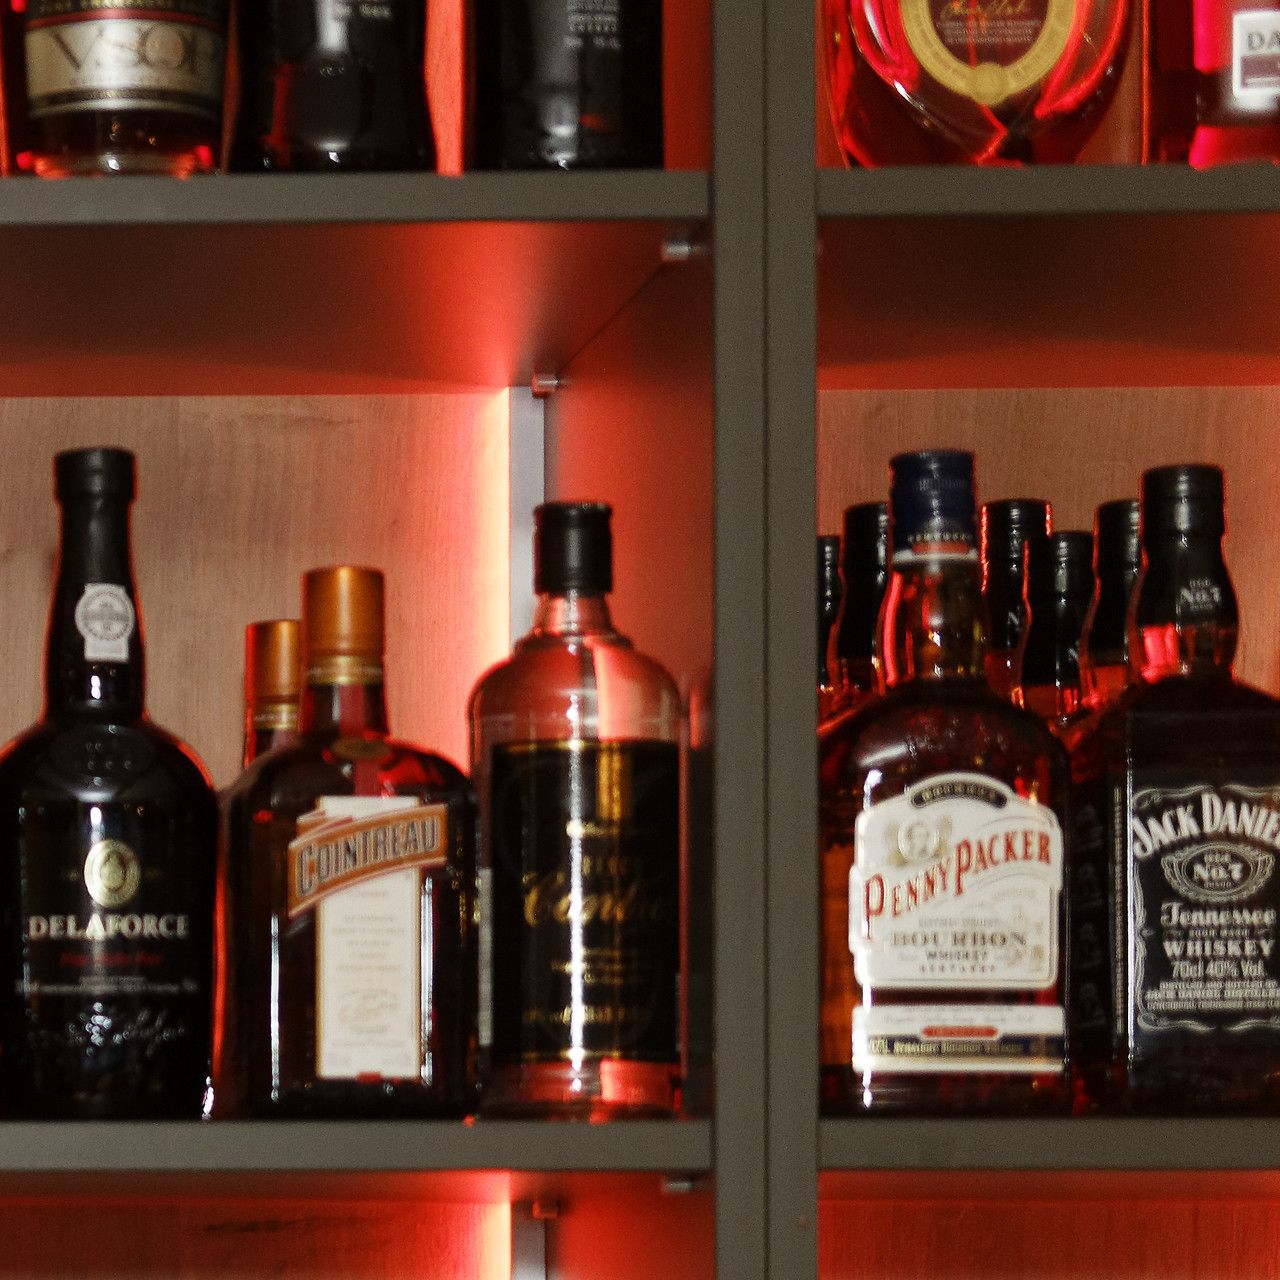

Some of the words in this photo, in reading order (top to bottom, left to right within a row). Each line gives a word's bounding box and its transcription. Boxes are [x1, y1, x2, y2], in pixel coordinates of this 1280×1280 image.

[1132, 804, 1201, 858] JACK
[1201, 792, 1280, 850] DANIE
[297, 815, 438, 898] COINTREAU
[26, 913, 190, 940] DELAFORCE
[1160, 901, 1277, 927] Tennessee
[891, 931, 1027, 947] BOURBON
[1162, 939, 1276, 958] WHISKEY
